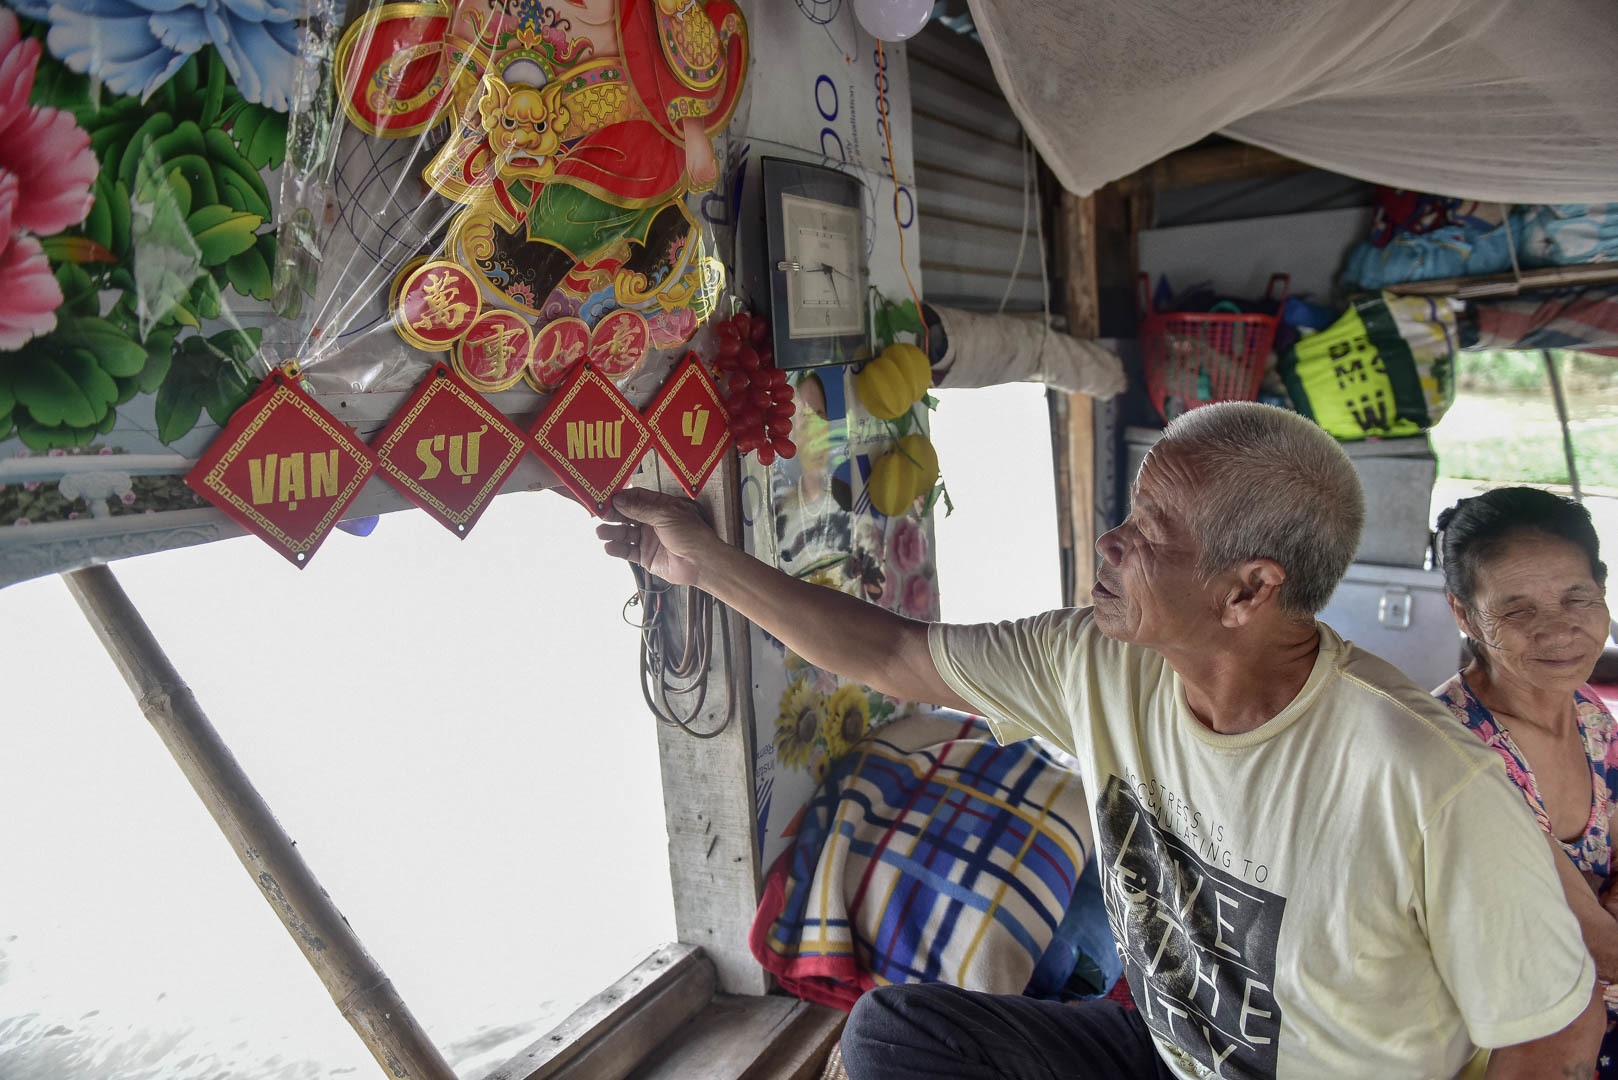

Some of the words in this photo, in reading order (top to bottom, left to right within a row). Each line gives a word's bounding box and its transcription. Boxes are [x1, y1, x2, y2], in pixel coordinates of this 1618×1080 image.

[247, 448, 340, 512] VẠN
[416, 423, 488, 485] SỰ
[565, 414, 623, 460] NHƯ
[683, 403, 710, 445] Ý
[1149, 778, 1202, 829] STRESS
[1210, 820, 1224, 843] IS
[1113, 811, 1241, 958] LIVE
[1243, 858, 1268, 883] TO
[1156, 910, 1272, 1044] THE
